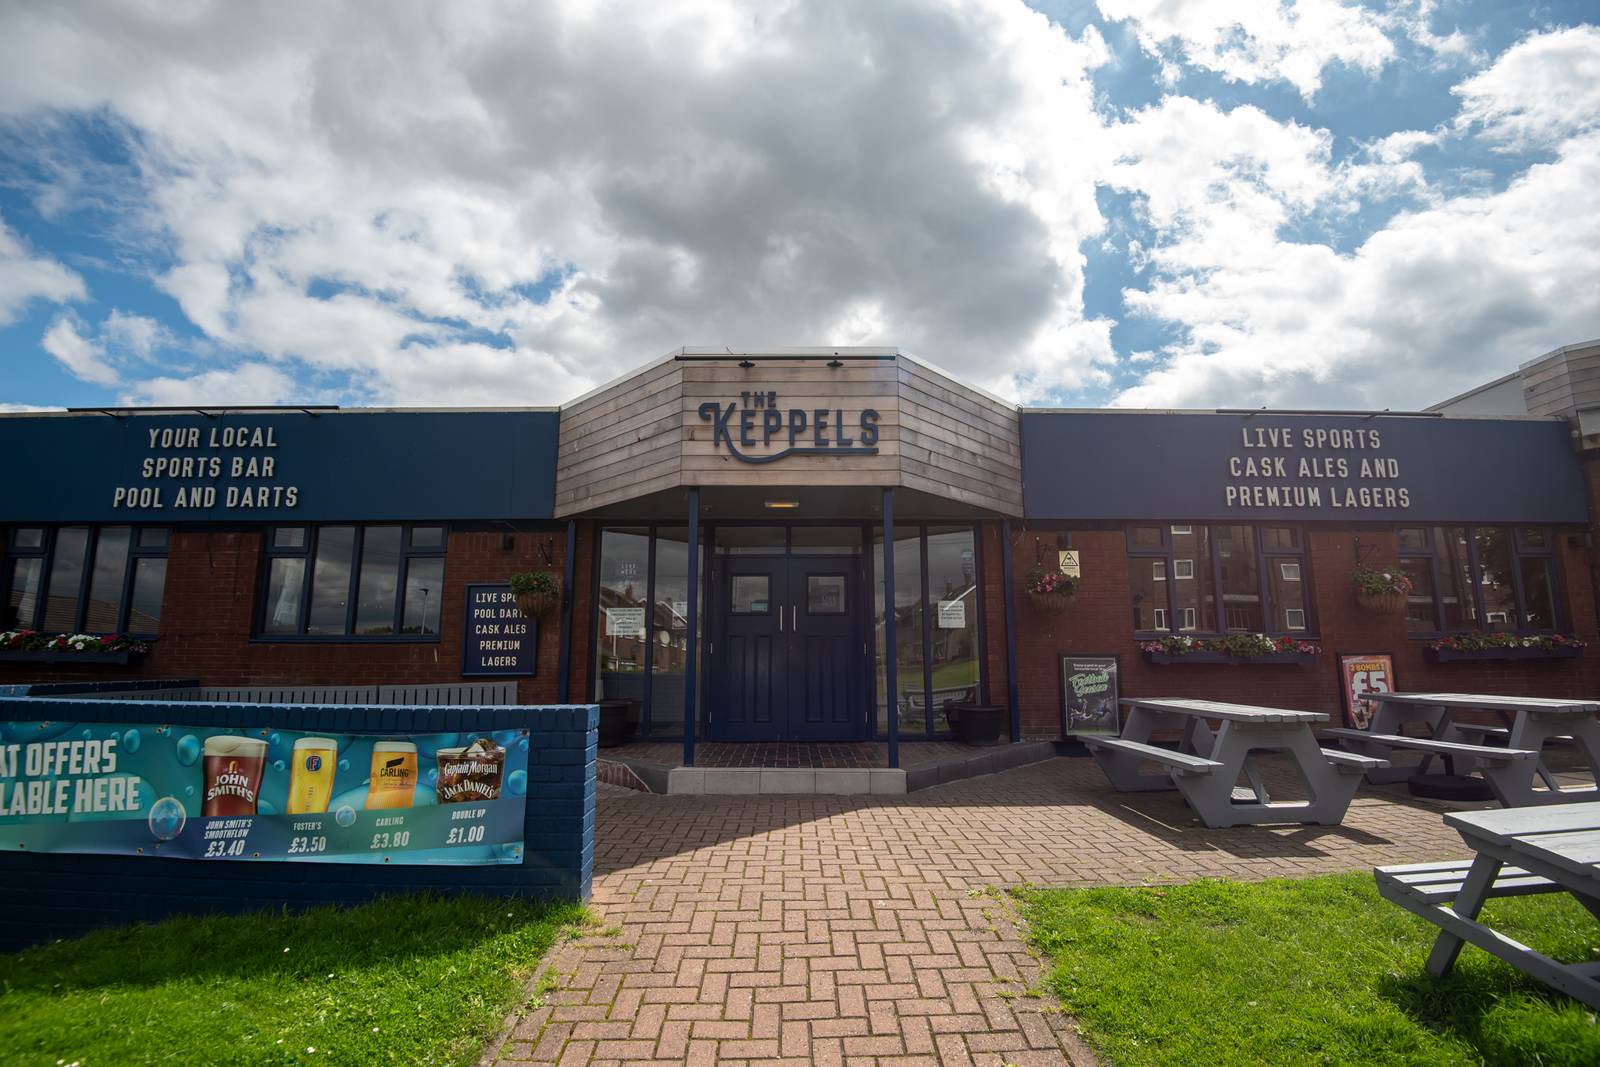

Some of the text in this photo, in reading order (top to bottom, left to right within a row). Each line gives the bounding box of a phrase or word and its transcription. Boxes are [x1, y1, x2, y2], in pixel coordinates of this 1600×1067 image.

[740, 391, 777, 408] THE
[149, 426, 277, 449] YOUR LOCAL
[698, 402, 880, 464] KEPPELS
[1242, 427, 1381, 450] LIVE SPORTS
[142, 456, 275, 478] SPORTS BAR
[1230, 456, 1400, 478] CASK ALES AND
[113, 486, 298, 508] POOL AND DARTS
[1226, 486, 1411, 508] PREMIUM LAGERS
[476, 593, 497, 603] LIVE
[474, 609, 496, 619] POOL
[475, 625, 527, 634] CASK ALES
[480, 641, 520, 650] PREMIUM
[481, 657, 517, 667] LAGERS
[1352, 671, 1388, 700] £5
[25, 739, 117, 776] OFFERS
[380, 768, 409, 777] CARLING
[444, 761, 498, 776] Captain Morgan
[215, 774, 249, 787] JOHN
[444, 779, 495, 799] JACK DANIEL'S
[74, 777, 141, 813] HERE
[207, 785, 254, 802] SMITH'S
[376, 816, 404, 827] CARLING
[452, 809, 486, 820] DOUBLE UP
[206, 819, 253, 830] JOHN SMITH'S
[293, 822, 322, 831] FOSTER'S
[204, 829, 249, 840] SMOOTHFLOW
[370, 831, 410, 849] £3.80
[446, 826, 486, 844] £1.00
[204, 840, 245, 857] £3.40
[288, 836, 327, 854] £3.50
